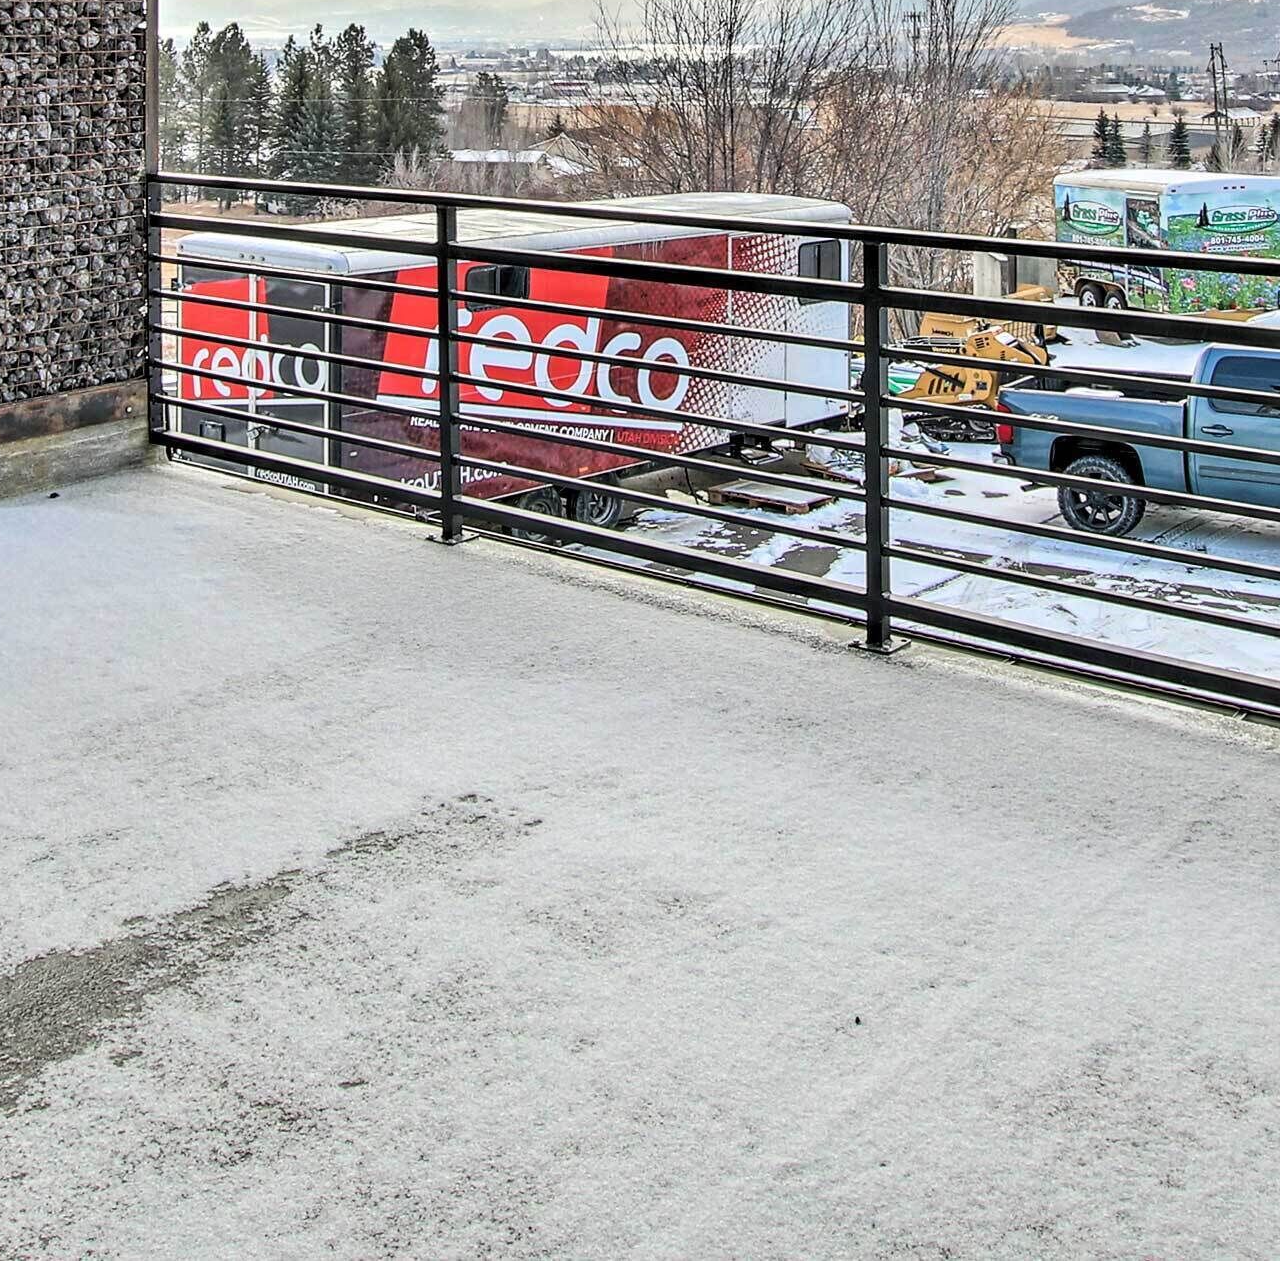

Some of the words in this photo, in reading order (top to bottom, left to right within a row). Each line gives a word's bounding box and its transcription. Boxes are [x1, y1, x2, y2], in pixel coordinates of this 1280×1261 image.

[1073, 204, 1096, 220] Grass
[1098, 207, 1118, 223] Plus
[1212, 210, 1246, 222] Grass
[1248, 208, 1275, 220] Plus
[1210, 235, 1265, 245] 801-745-4004
[192, 334, 328, 398] redco
[560, 426, 609, 441] COMPANY
[617, 430, 641, 442] UTAH
[256, 468, 316, 492] redcoUTAH.com
